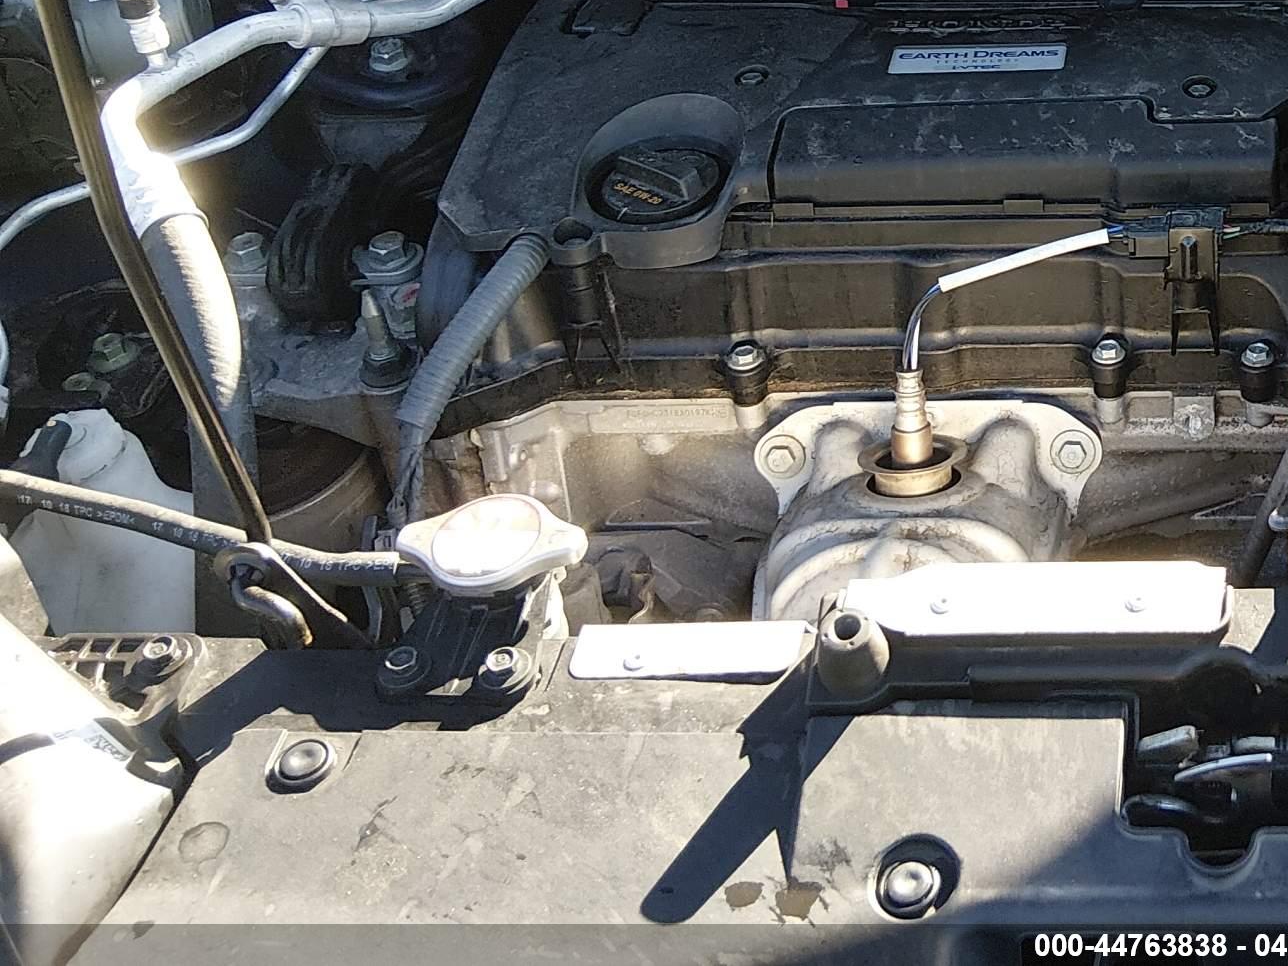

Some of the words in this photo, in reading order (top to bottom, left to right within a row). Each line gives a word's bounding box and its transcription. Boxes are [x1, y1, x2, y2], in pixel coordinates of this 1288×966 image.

[899, 51, 969, 60] EARTH
[974, 49, 1058, 58] DREAMS
[613, 183, 637, 194] SAE
